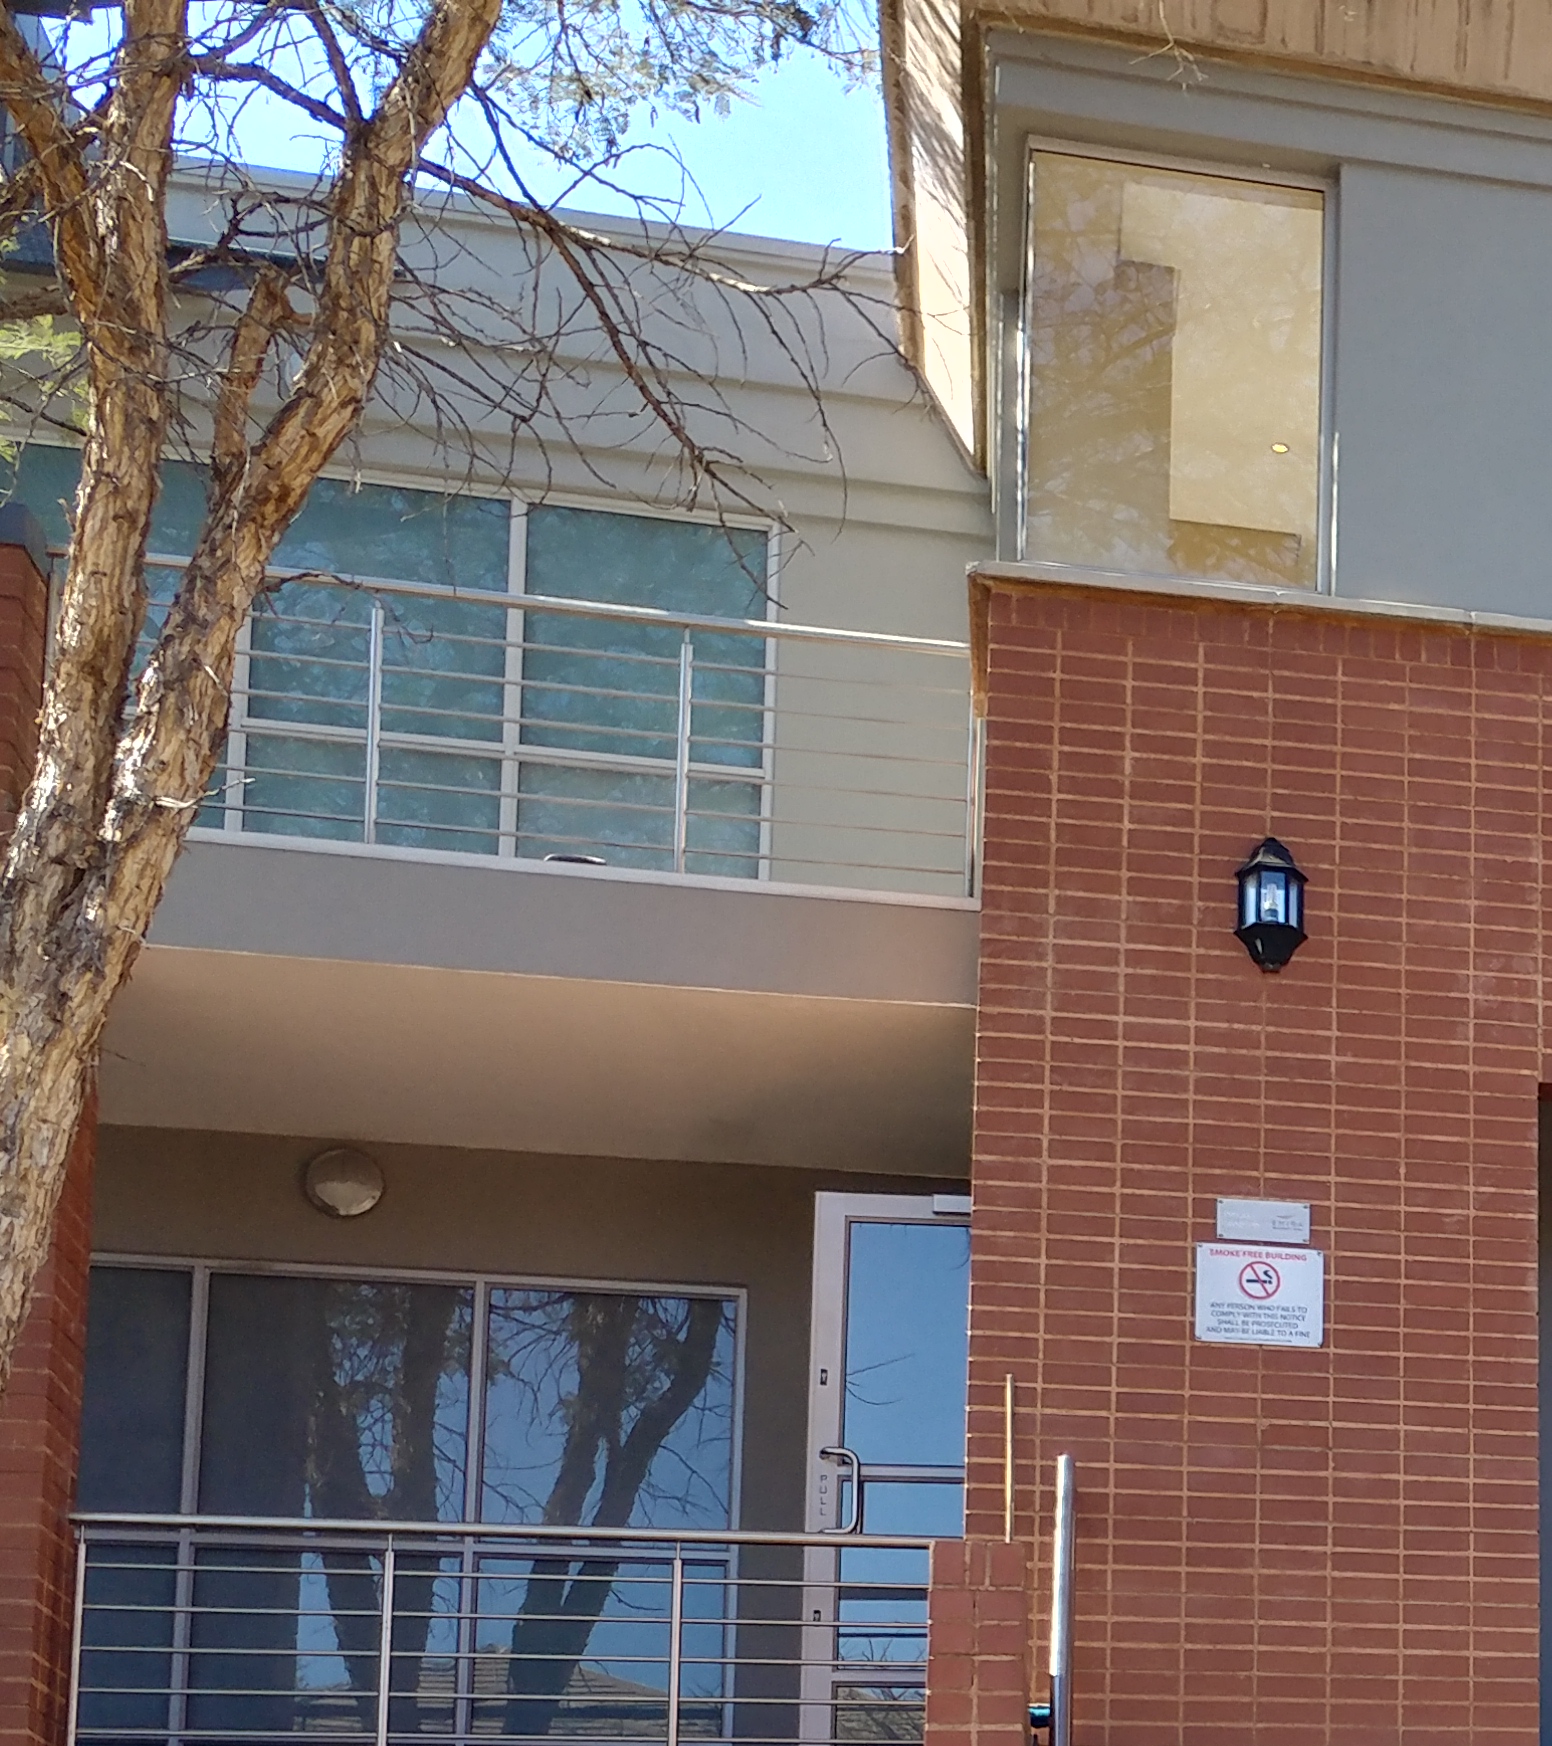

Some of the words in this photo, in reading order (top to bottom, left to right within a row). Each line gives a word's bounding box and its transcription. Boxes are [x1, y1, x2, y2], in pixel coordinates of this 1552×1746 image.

[1209, 1248, 1240, 1257] SMOKE
[1242, 1250, 1263, 1258] FREE
[1265, 1252, 1307, 1261] BUILDING
